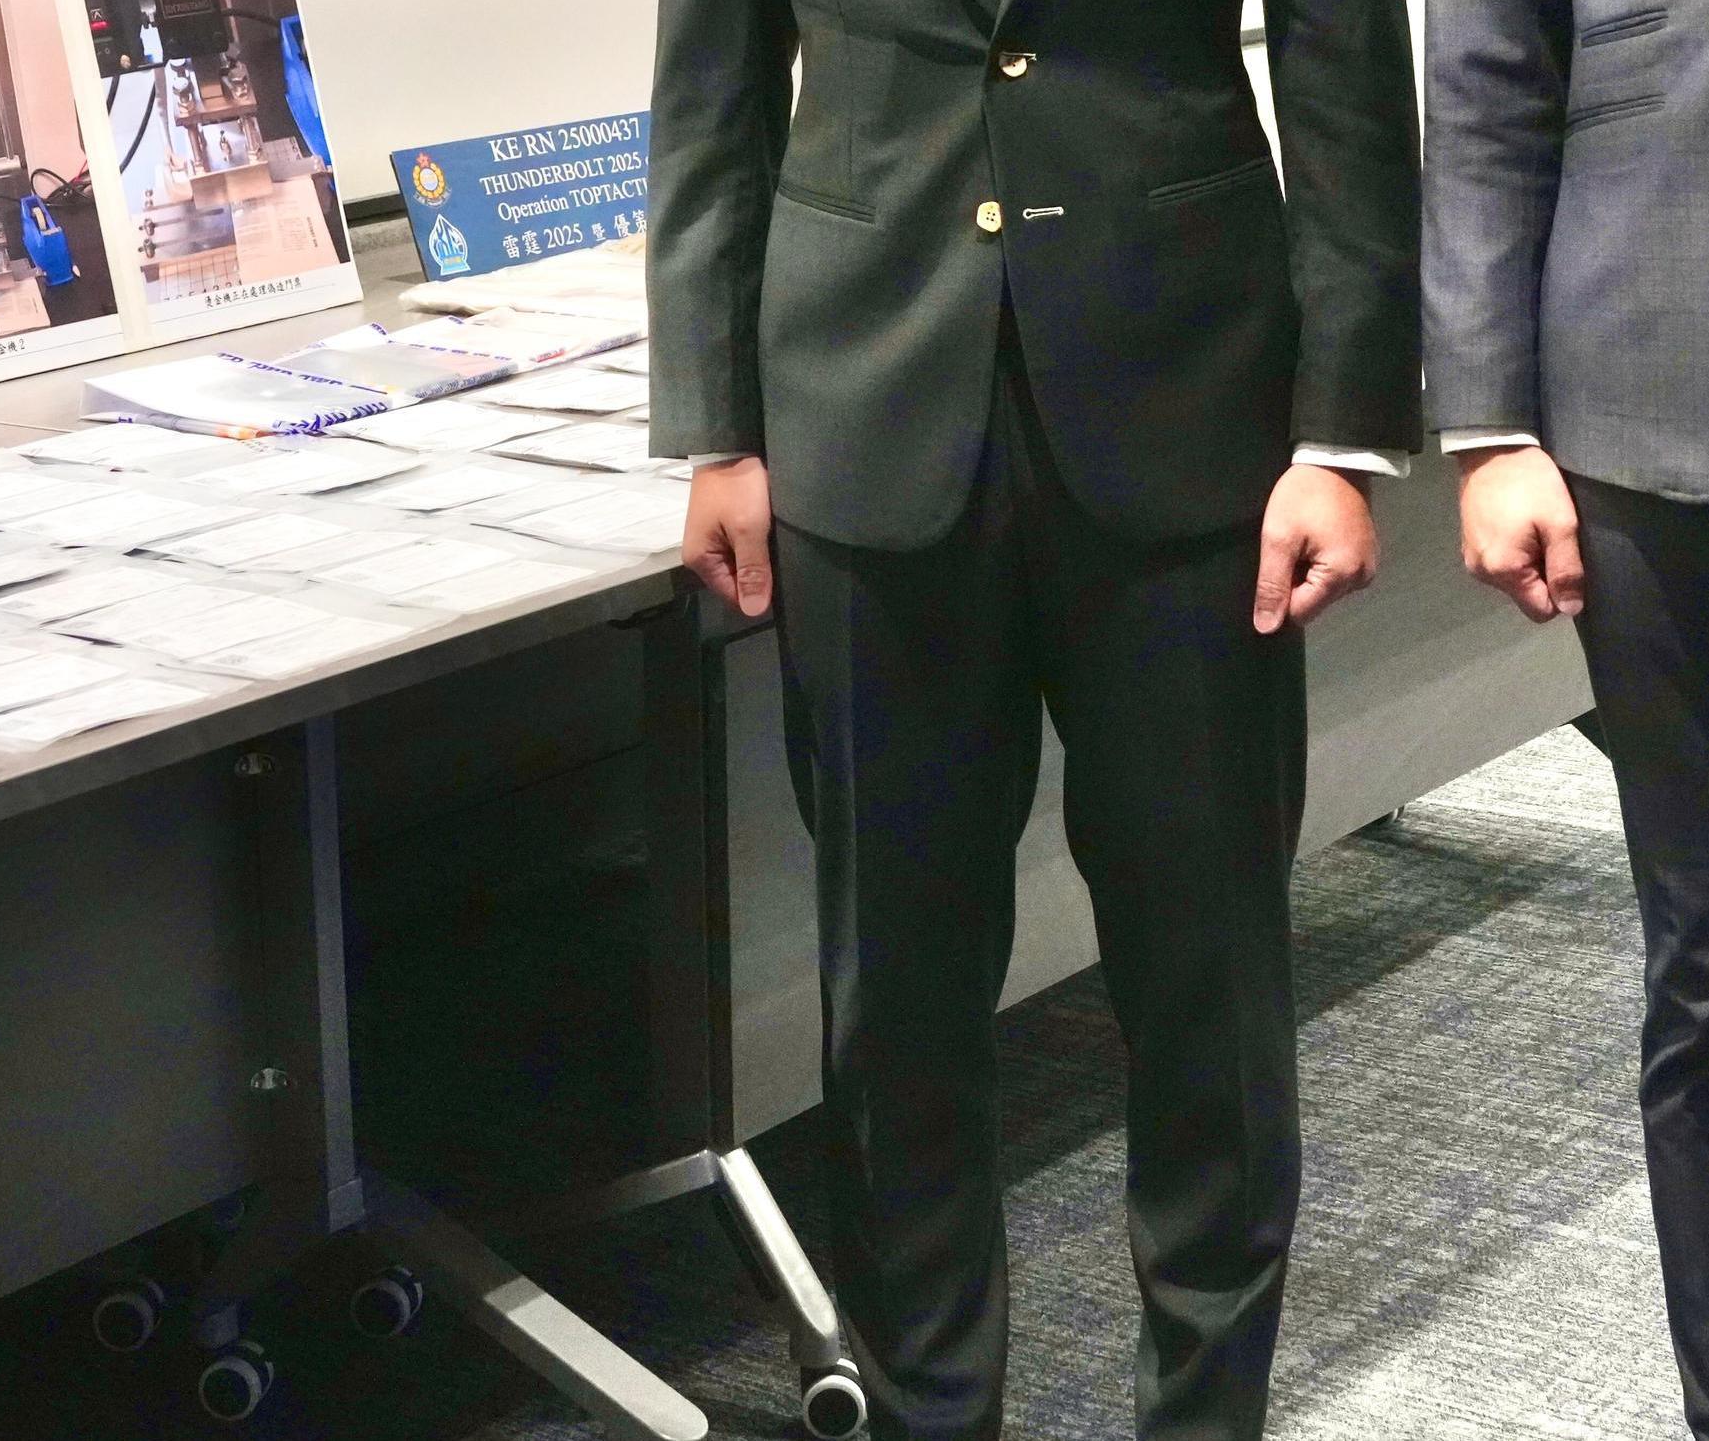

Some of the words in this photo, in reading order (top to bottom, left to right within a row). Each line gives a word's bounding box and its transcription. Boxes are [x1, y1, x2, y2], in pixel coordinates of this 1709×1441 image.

[488, 136, 523, 163] KE
[524, 130, 556, 157] RN
[558, 117, 640, 152] 25000437
[479, 158, 606, 196] THUNDERBOLT
[607, 151, 642, 174] 2025
[497, 196, 570, 224] Operation
[502, 231, 542, 259] 雷霆
[543, 223, 584, 250] 2025
[591, 222, 606, 241] 暨
